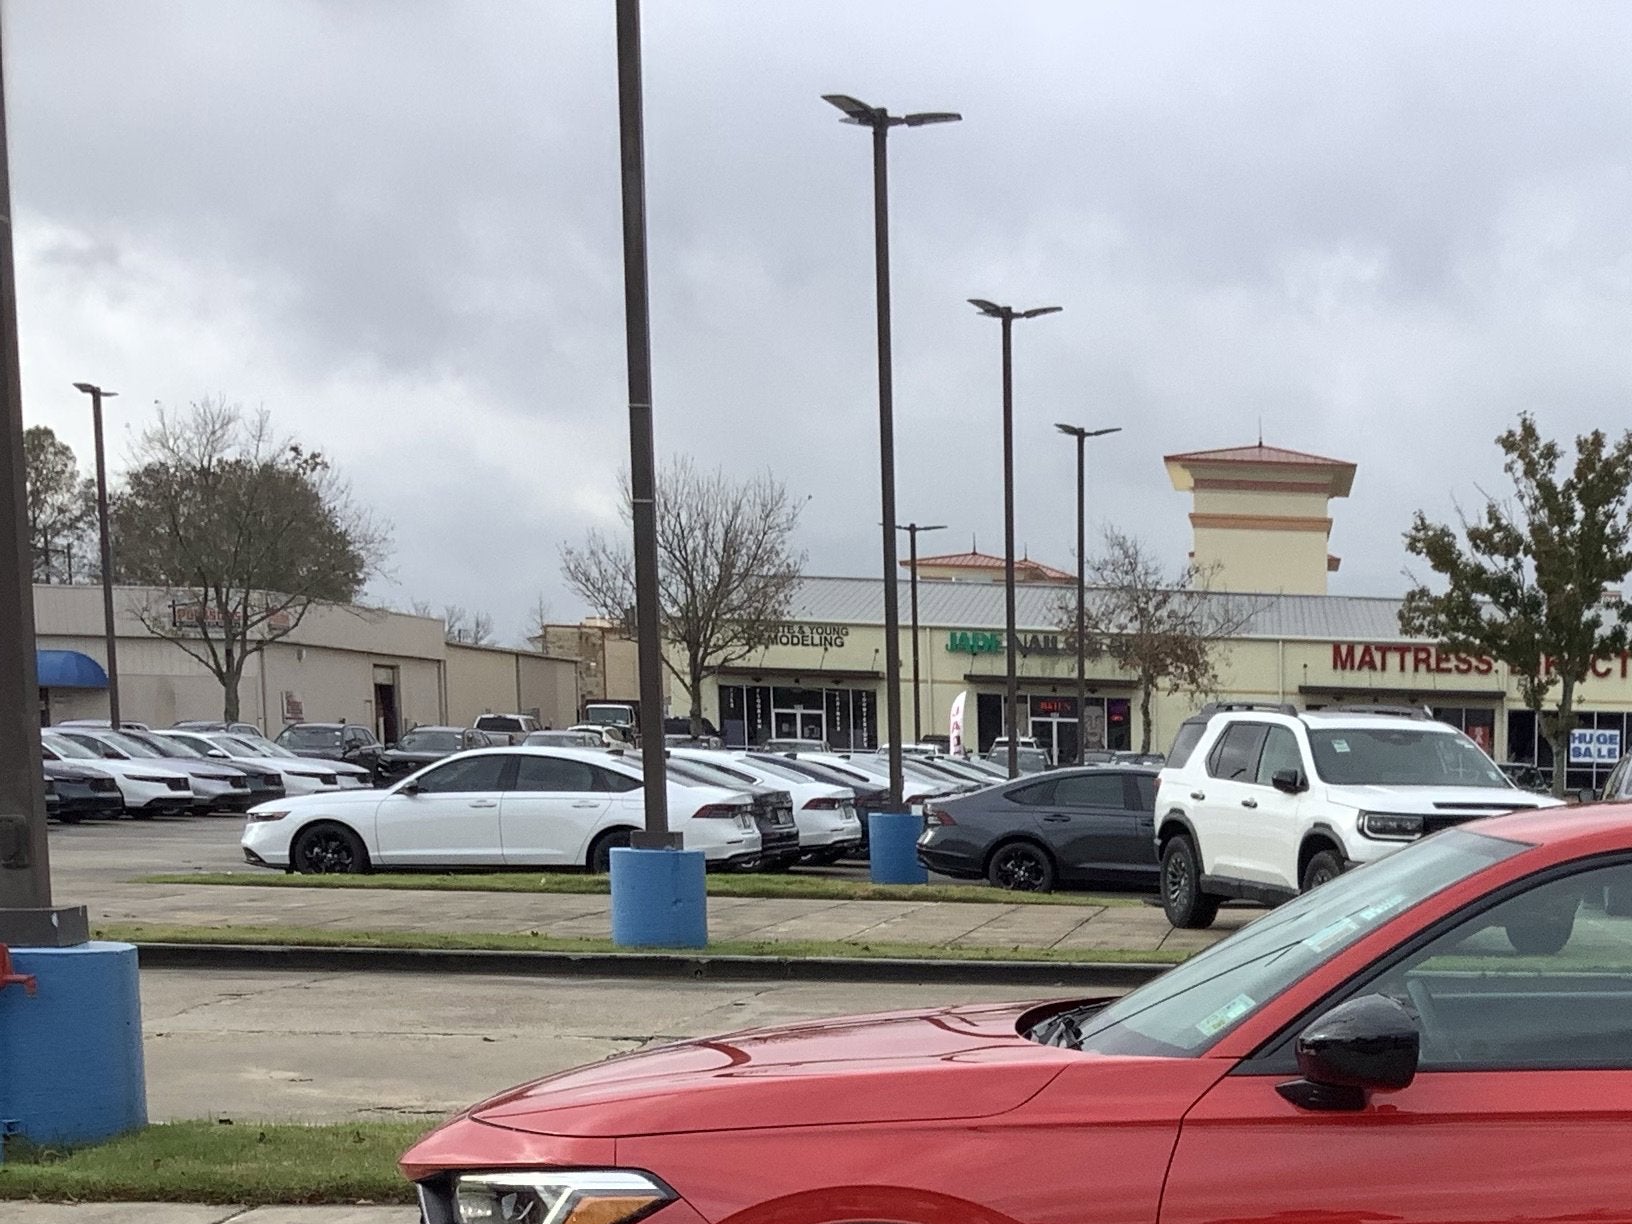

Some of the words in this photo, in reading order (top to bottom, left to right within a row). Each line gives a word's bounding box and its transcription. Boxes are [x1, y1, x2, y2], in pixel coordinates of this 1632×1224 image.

[809, 626, 849, 636] YOUNG
[945, 631, 1005, 655] JADE
[1332, 643, 1494, 675] MATTRESS
[1570, 733, 1619, 746] HUGE
[1571, 747, 1618, 760] SALE
